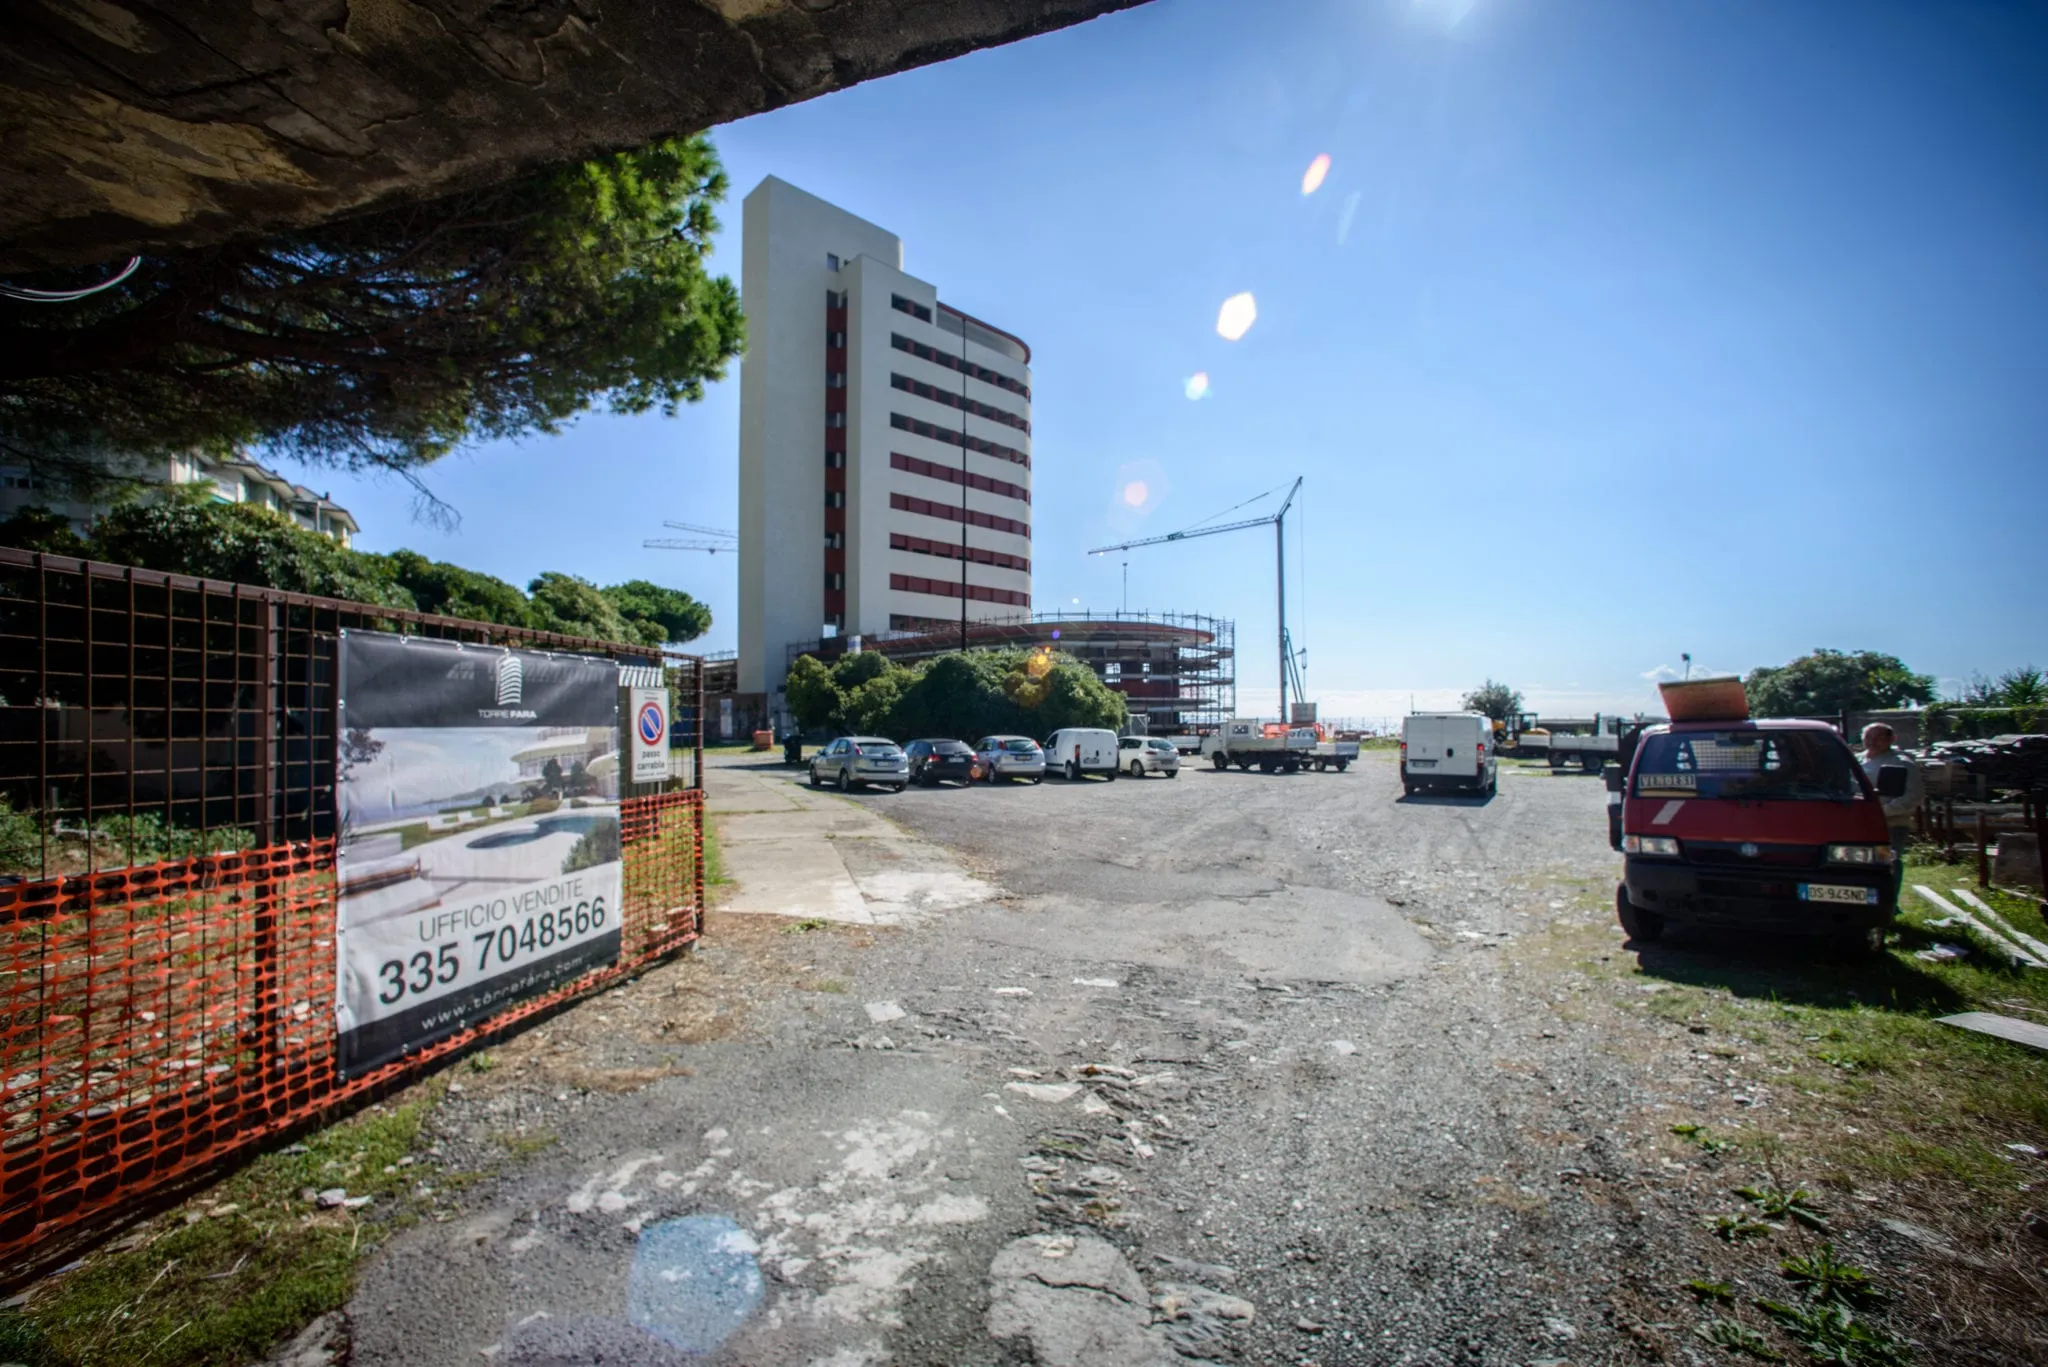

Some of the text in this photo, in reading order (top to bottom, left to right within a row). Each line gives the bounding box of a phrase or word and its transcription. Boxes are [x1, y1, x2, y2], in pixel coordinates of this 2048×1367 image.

[478, 709, 537, 718] TORRE FARA
[419, 878, 583, 942] UFFICIO VENDITE
[379, 896, 606, 1005] 335 7048566
